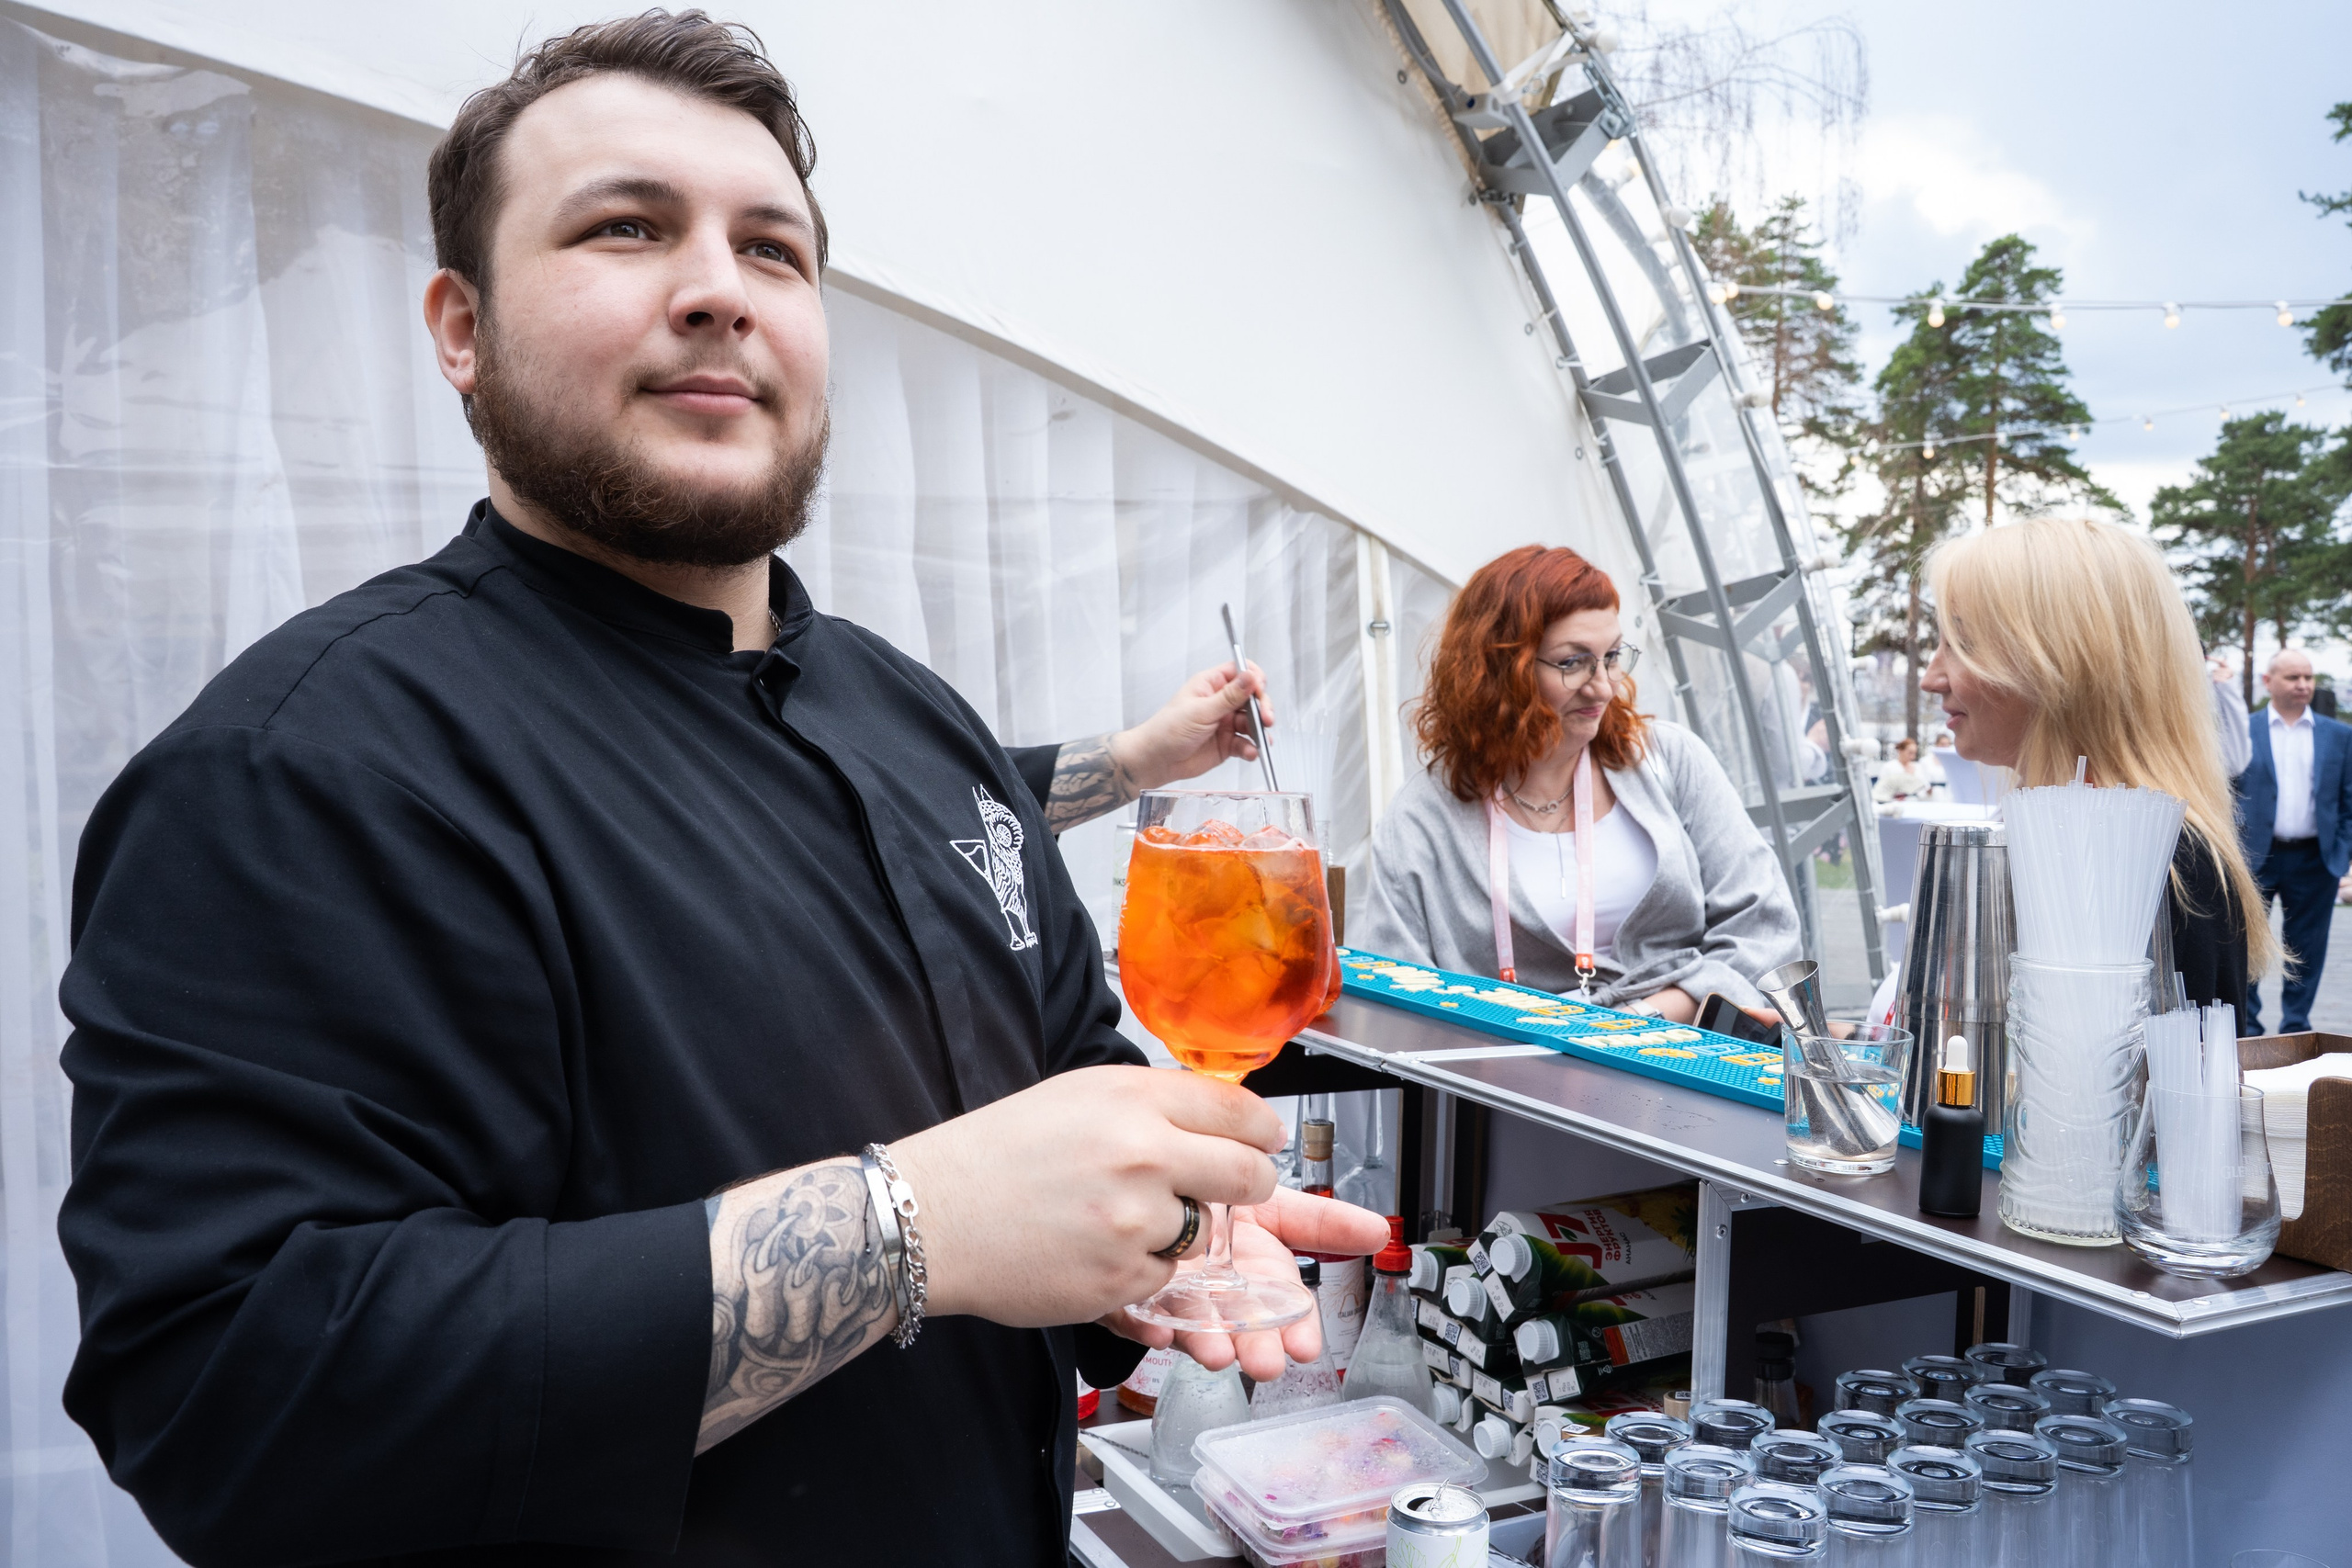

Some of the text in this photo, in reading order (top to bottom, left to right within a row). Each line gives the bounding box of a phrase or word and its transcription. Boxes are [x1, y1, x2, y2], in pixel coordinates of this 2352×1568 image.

[1534, 1213, 1603, 1269] J7
[1583, 1210, 1613, 1261] ЭНЕРГИЯ
[1592, 1209, 1622, 1261] ФРУКТОВ
[1619, 1231, 1632, 1265] АНАНАС
